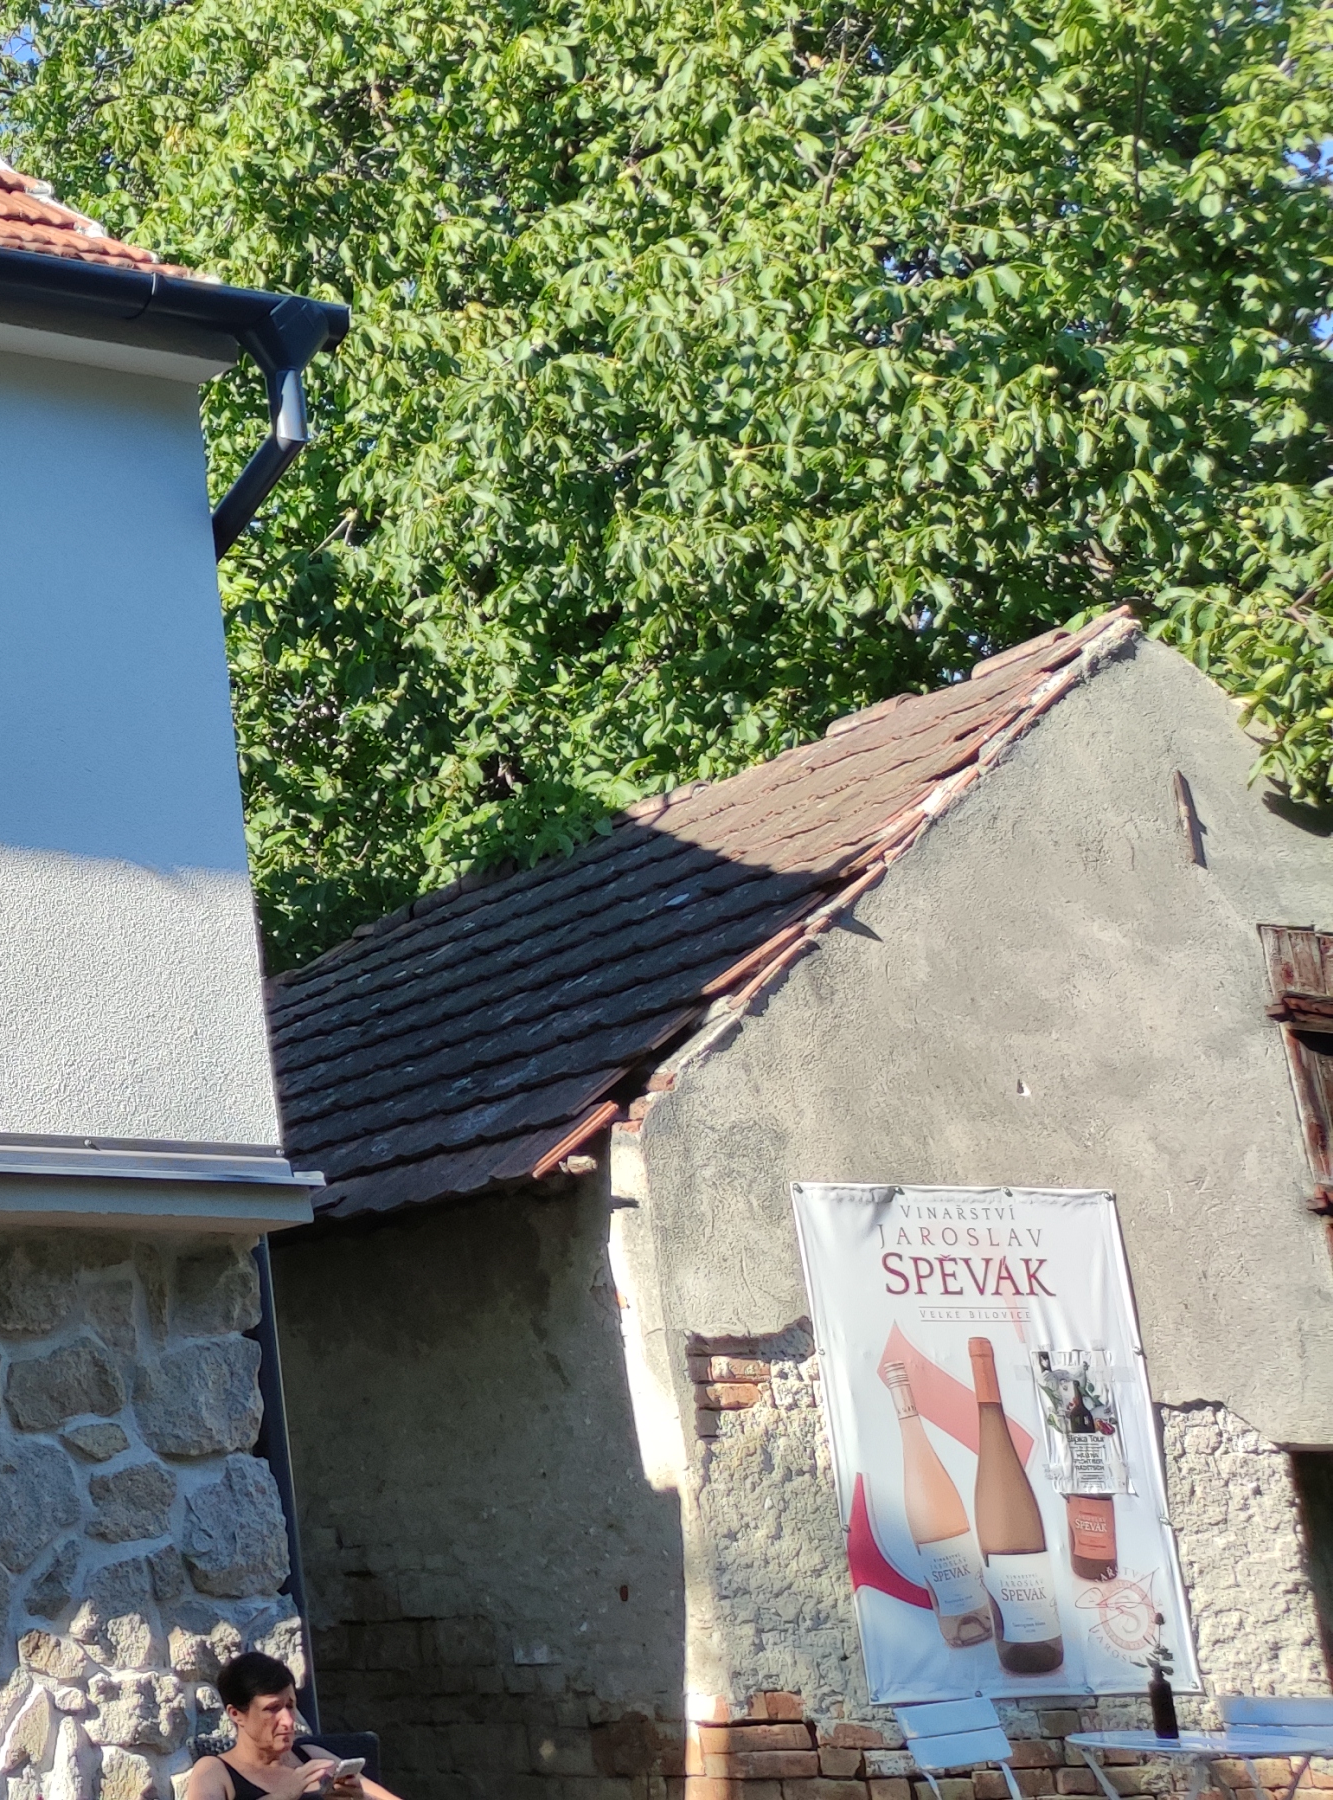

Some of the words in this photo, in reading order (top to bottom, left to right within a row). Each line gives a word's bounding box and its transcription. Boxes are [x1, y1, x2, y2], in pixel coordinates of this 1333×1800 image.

[900, 1204, 1016, 1221] VINAŘSTVÍ
[876, 1223, 1042, 1249] JAROSLAV
[881, 1252, 1057, 1297] SPĚVÁK
